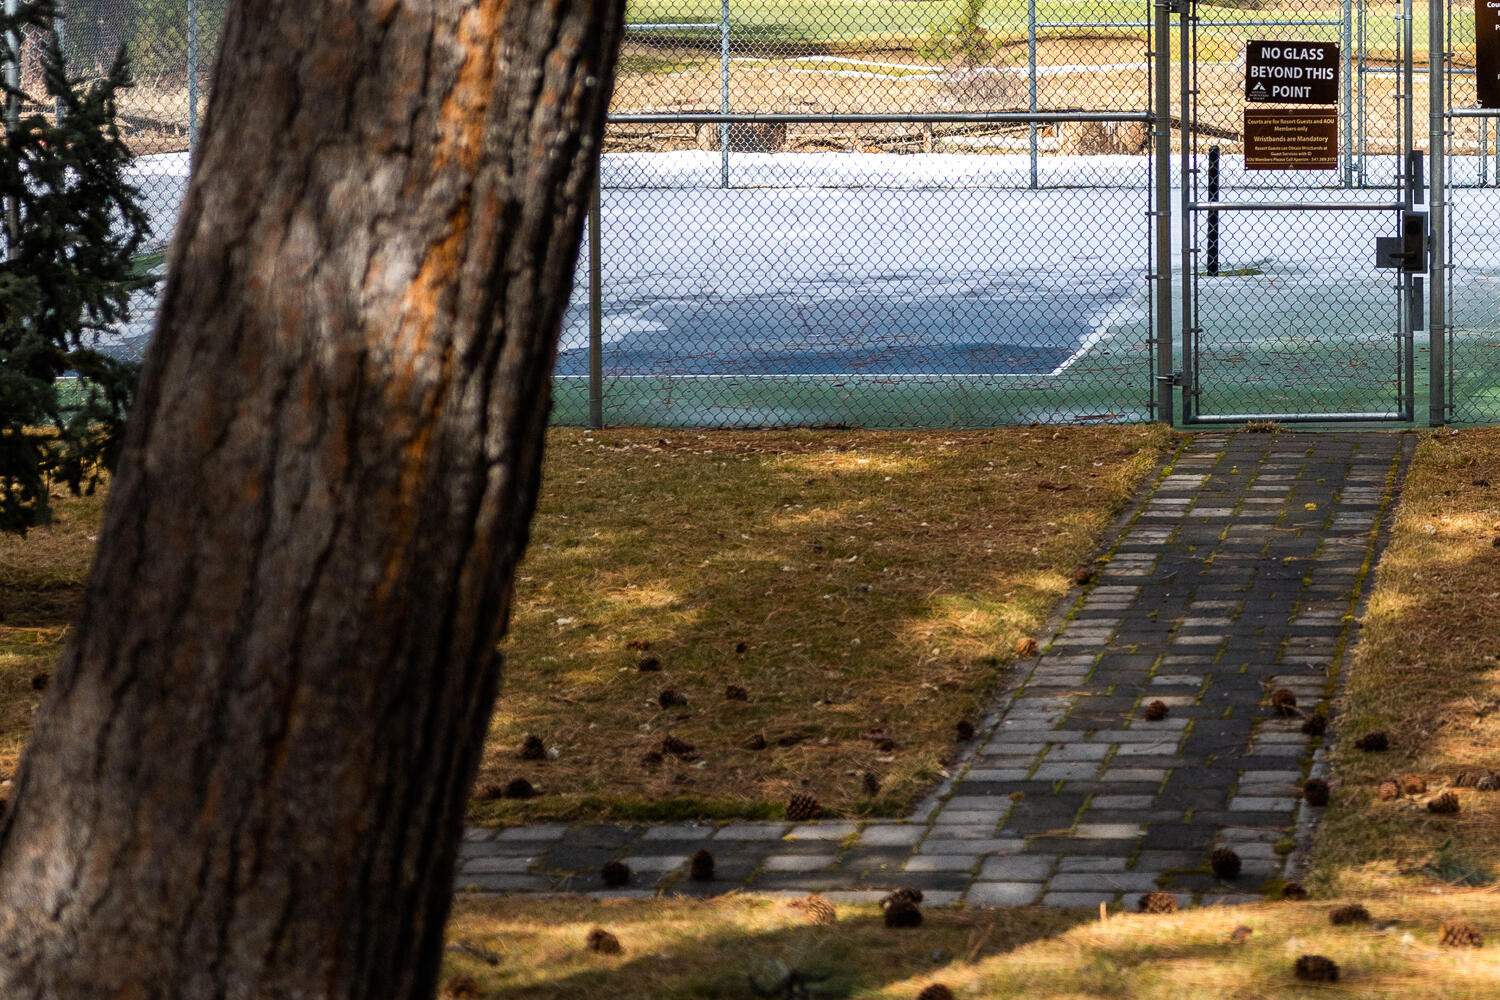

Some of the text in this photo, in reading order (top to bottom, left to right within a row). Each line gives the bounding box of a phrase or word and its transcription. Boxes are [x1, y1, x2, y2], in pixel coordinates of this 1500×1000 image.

[1261, 47, 1324, 60] NO GLASS
[1251, 66, 1334, 80] BEYOND THIS
[1272, 86, 1311, 98] POINT
